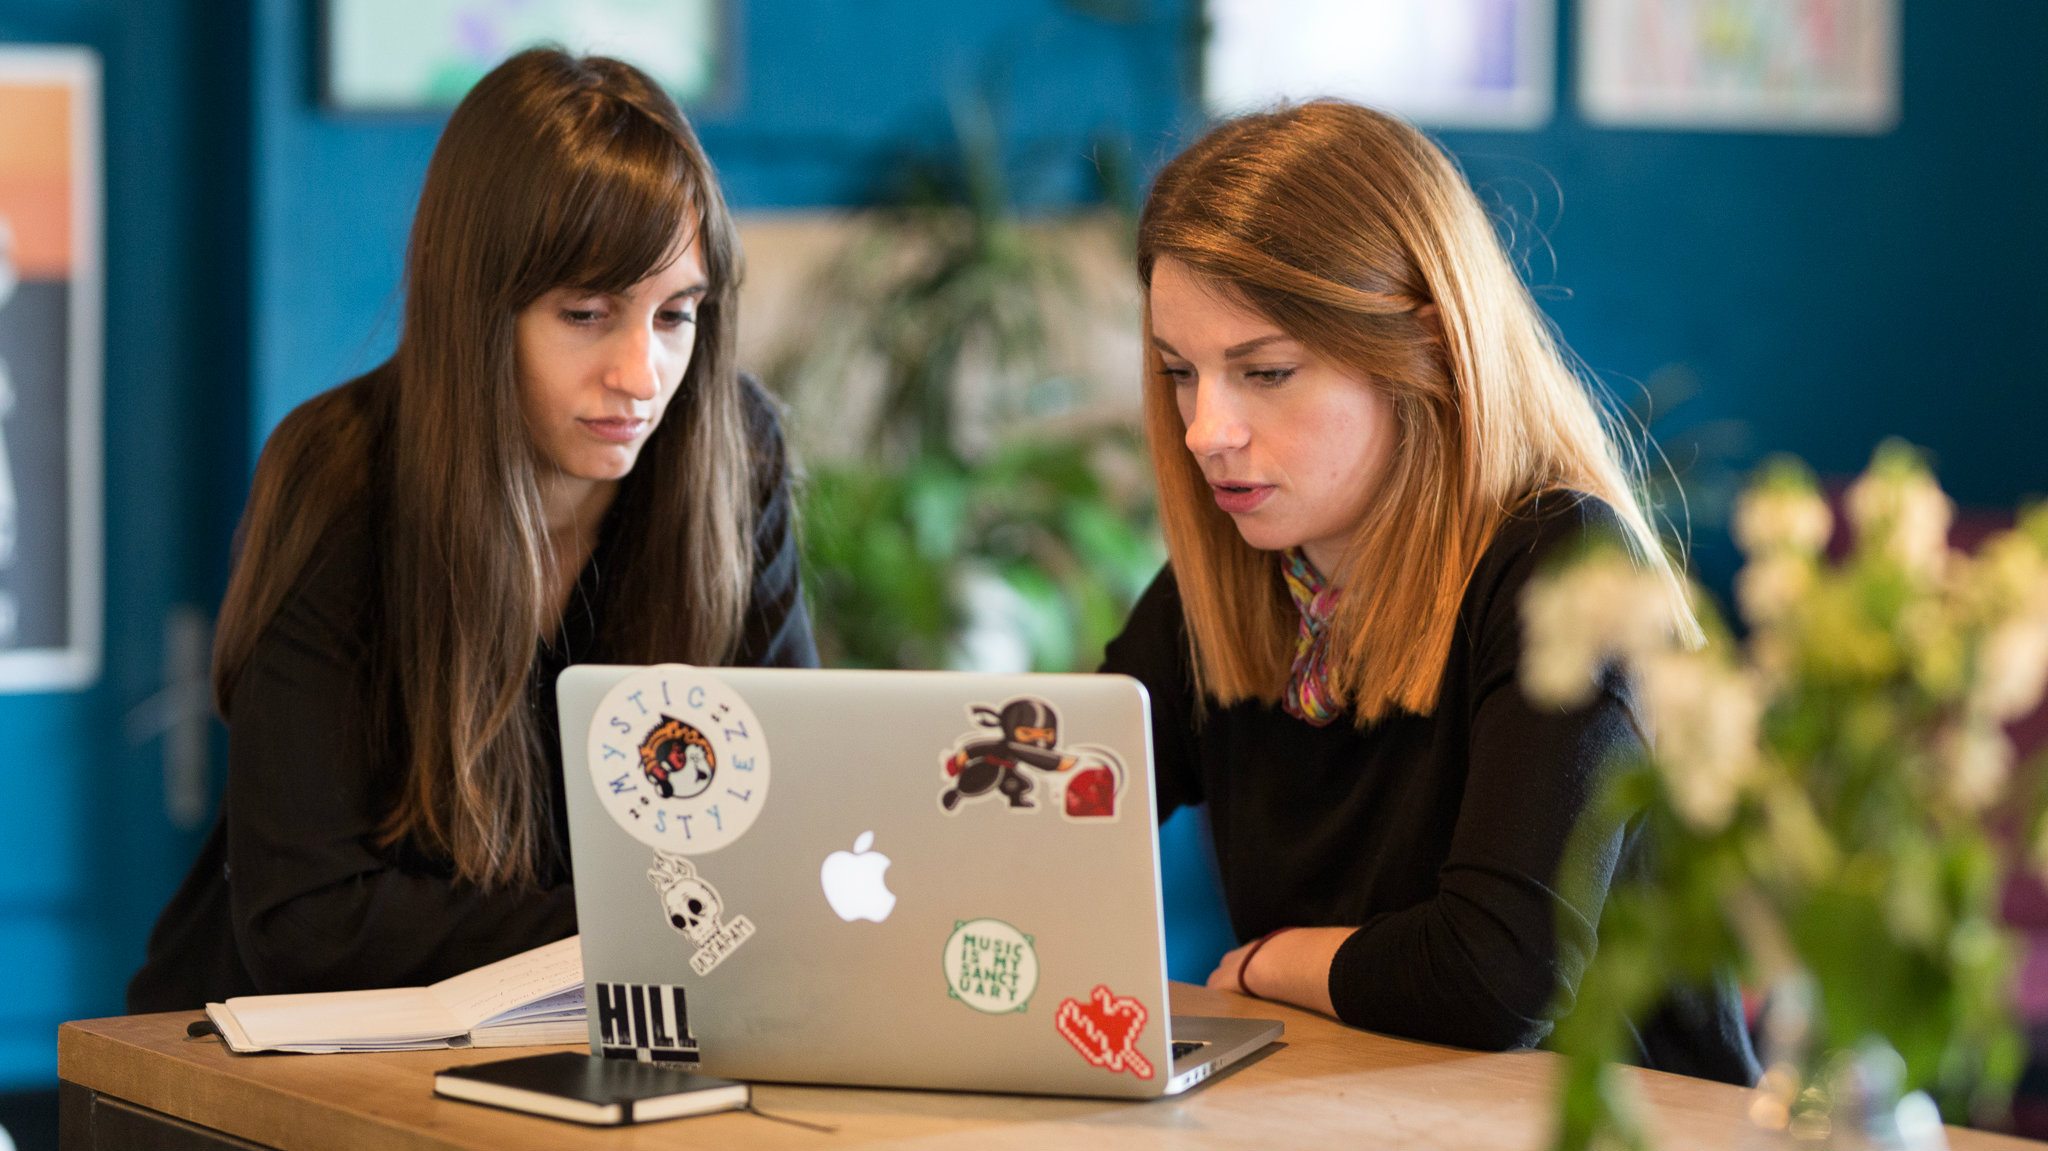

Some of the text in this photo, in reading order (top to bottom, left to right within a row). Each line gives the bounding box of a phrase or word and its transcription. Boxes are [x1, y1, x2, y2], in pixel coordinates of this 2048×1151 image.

[602, 681, 705, 795] MYSTIC
[654, 720, 755, 840] STYLEZ
[963, 933, 1023, 958] MUSIC
[961, 947, 1020, 972] IS MY
[961, 962, 1019, 987] SANCT
[960, 979, 1017, 1001] UARY
[596, 982, 698, 1049] HILL
